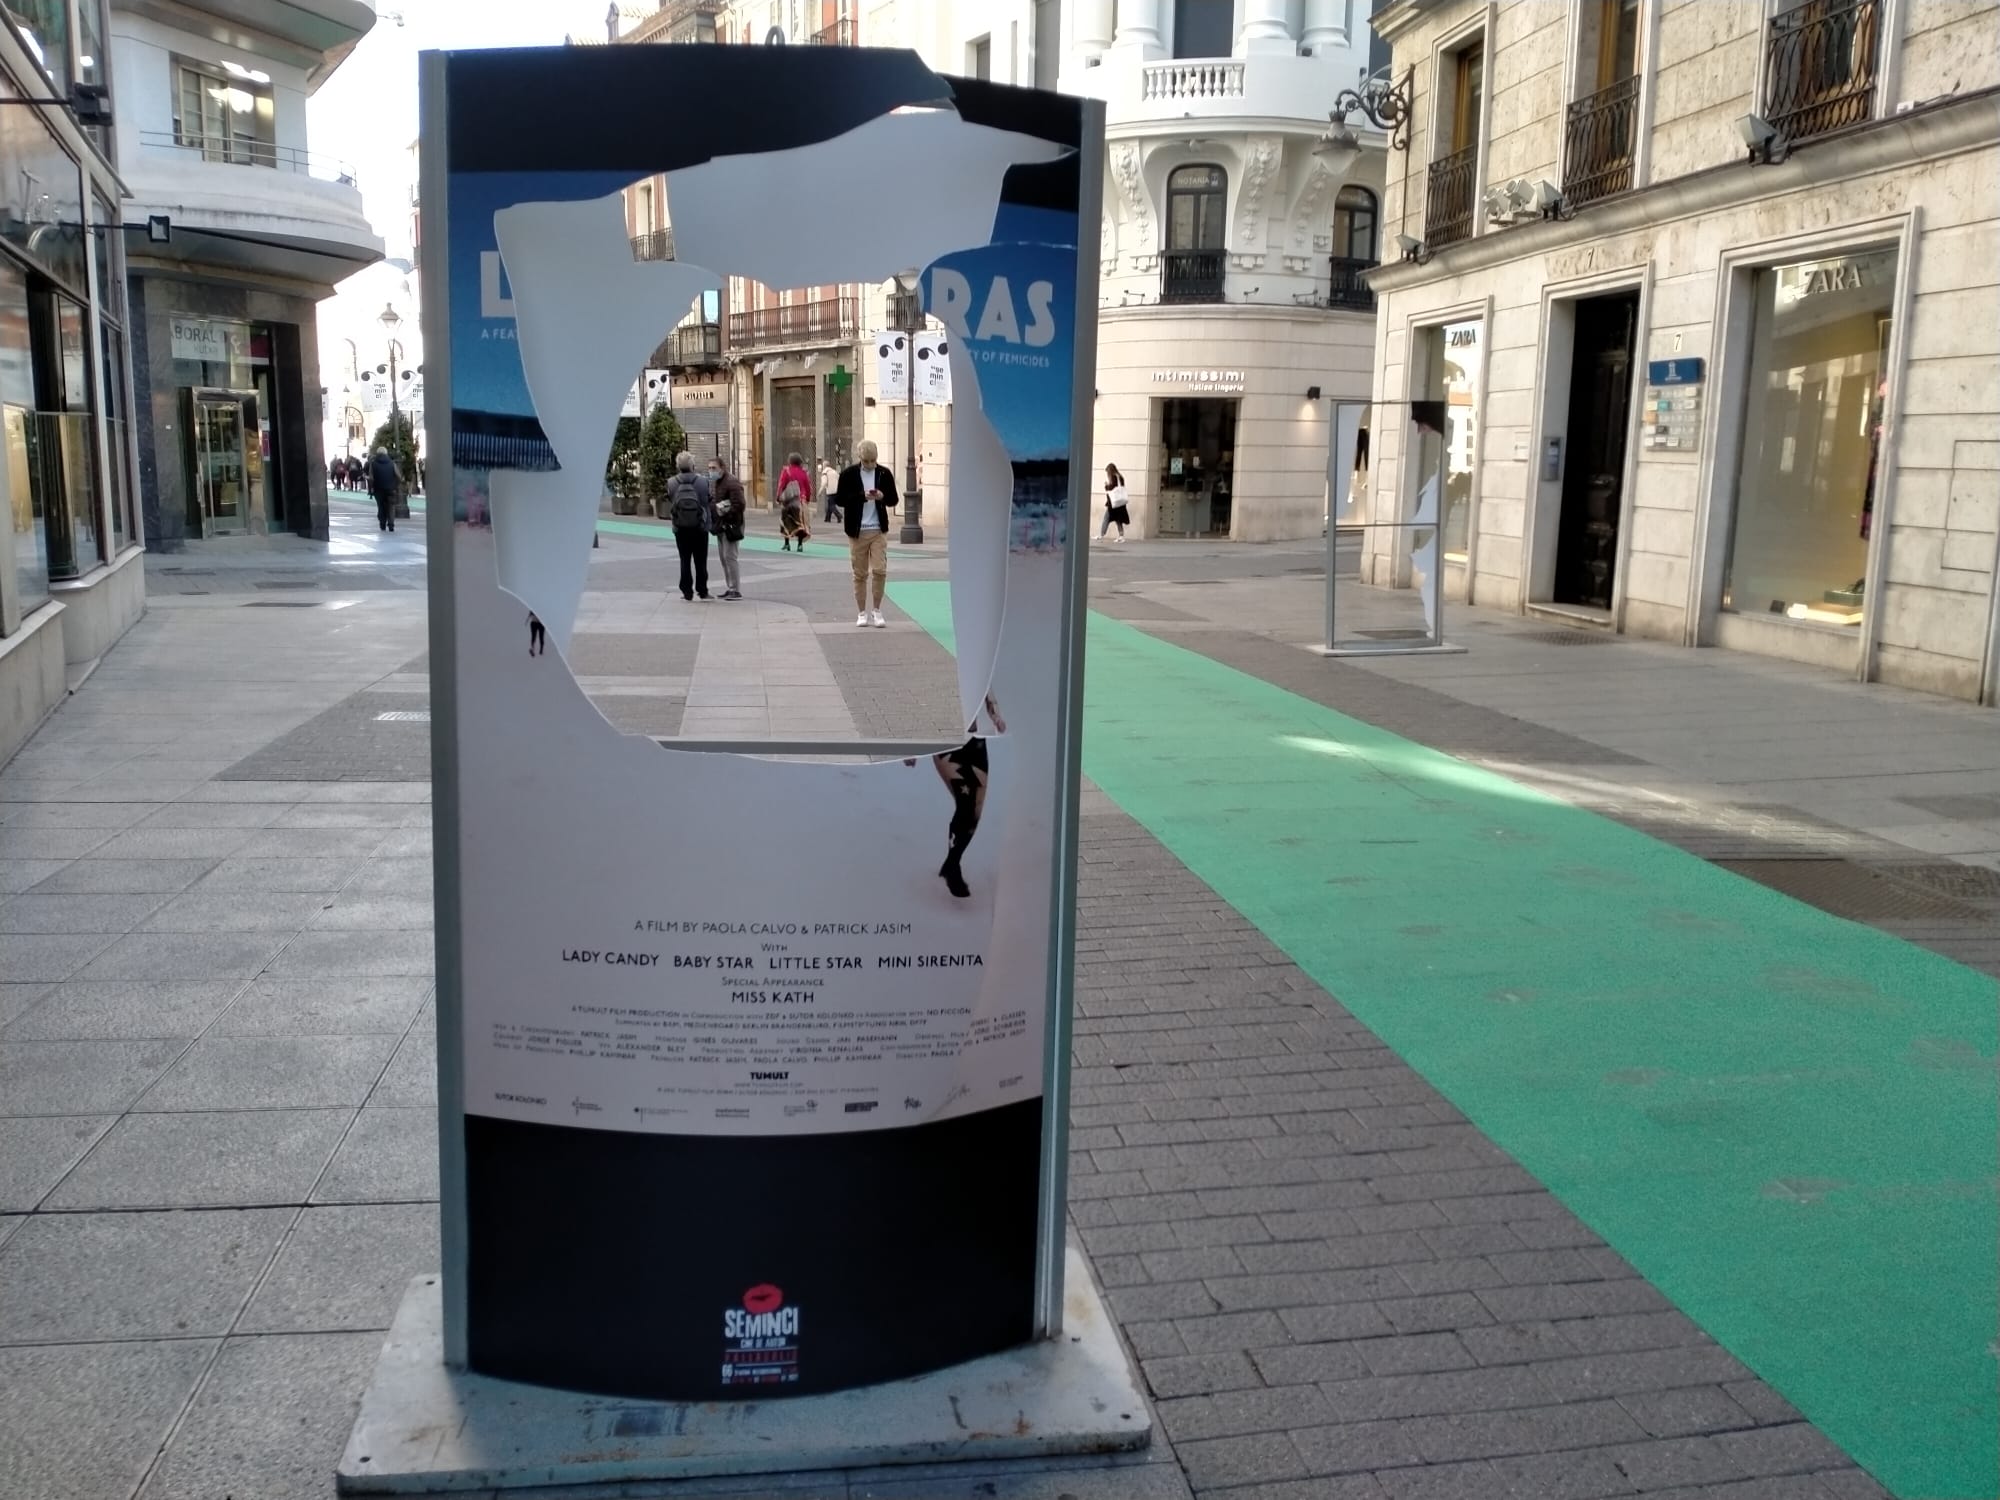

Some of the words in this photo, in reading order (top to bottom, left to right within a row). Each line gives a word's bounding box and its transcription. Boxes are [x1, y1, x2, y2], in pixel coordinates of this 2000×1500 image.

[1804, 264, 1862, 294] ZARA
[919, 267, 1055, 348] RAS
[173, 325, 216, 344] BORAL
[481, 328, 489, 339] A
[493, 328, 516, 339] FEA
[1451, 329, 1477, 346] ZARA
[982, 351, 996, 362] OF
[999, 352, 1050, 368] FEMICIDES
[1152, 370, 1245, 382] intimissimi
[634, 920, 644, 931] A
[647, 920, 678, 932] FILM
[682, 922, 699, 933] BY
[702, 922, 747, 934] PAOLA
[750, 923, 796, 934] CALVO
[801, 924, 809, 935] &
[814, 923, 869, 935] PATRICK
[873, 923, 911, 935] JASIM
[562, 949, 601, 963] LADY
[605, 952, 659, 966] CANDY
[674, 955, 712, 968] BABY
[716, 956, 754, 969] STAR
[770, 957, 821, 969] LITTLE
[826, 956, 863, 969] STAR
[878, 956, 911, 968] MINI
[917, 954, 984, 968] SIRENITA
[731, 991, 767, 1004] MISS
[772, 991, 814, 1004] KATH
[628, 1009, 680, 1018] PRODUCTION
[750, 1071, 789, 1081] TUMULT
[725, 1306, 799, 1338] SEMINCI
